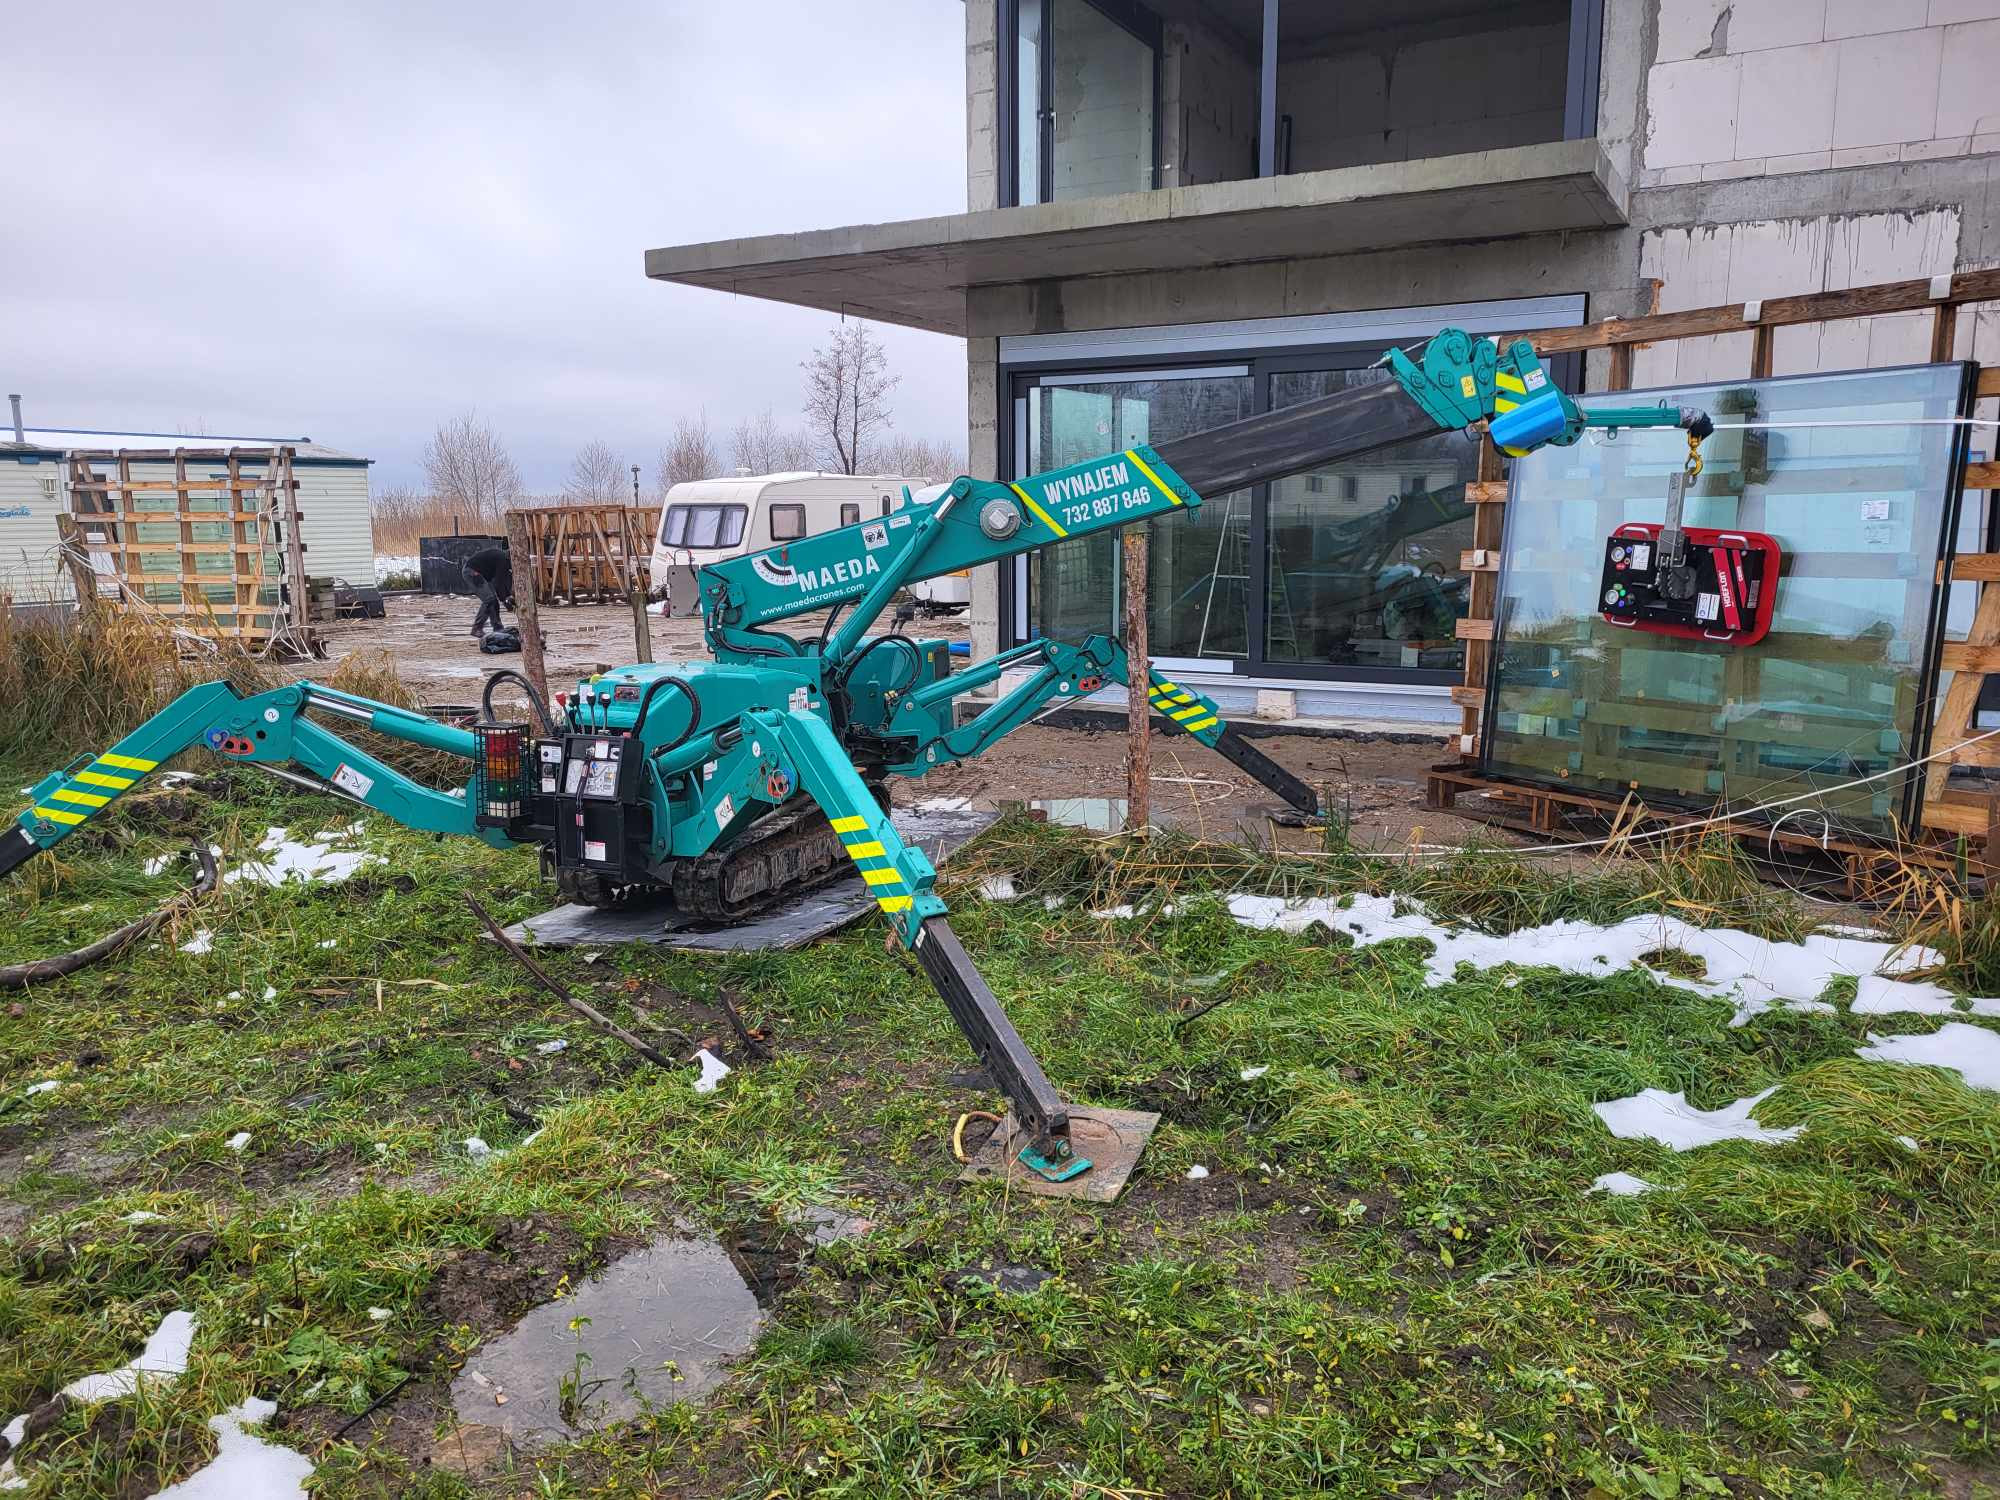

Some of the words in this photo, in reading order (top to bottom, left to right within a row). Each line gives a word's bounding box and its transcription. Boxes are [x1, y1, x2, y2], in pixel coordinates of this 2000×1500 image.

[1043, 461, 1129, 505] WYNAJEM
[1062, 503, 1091, 526] 732
[1092, 494, 1119, 517] 887
[1122, 486, 1151, 509] 846
[798, 554, 880, 592] MAEDA
[760, 583, 865, 616] www.maedacranes.com
